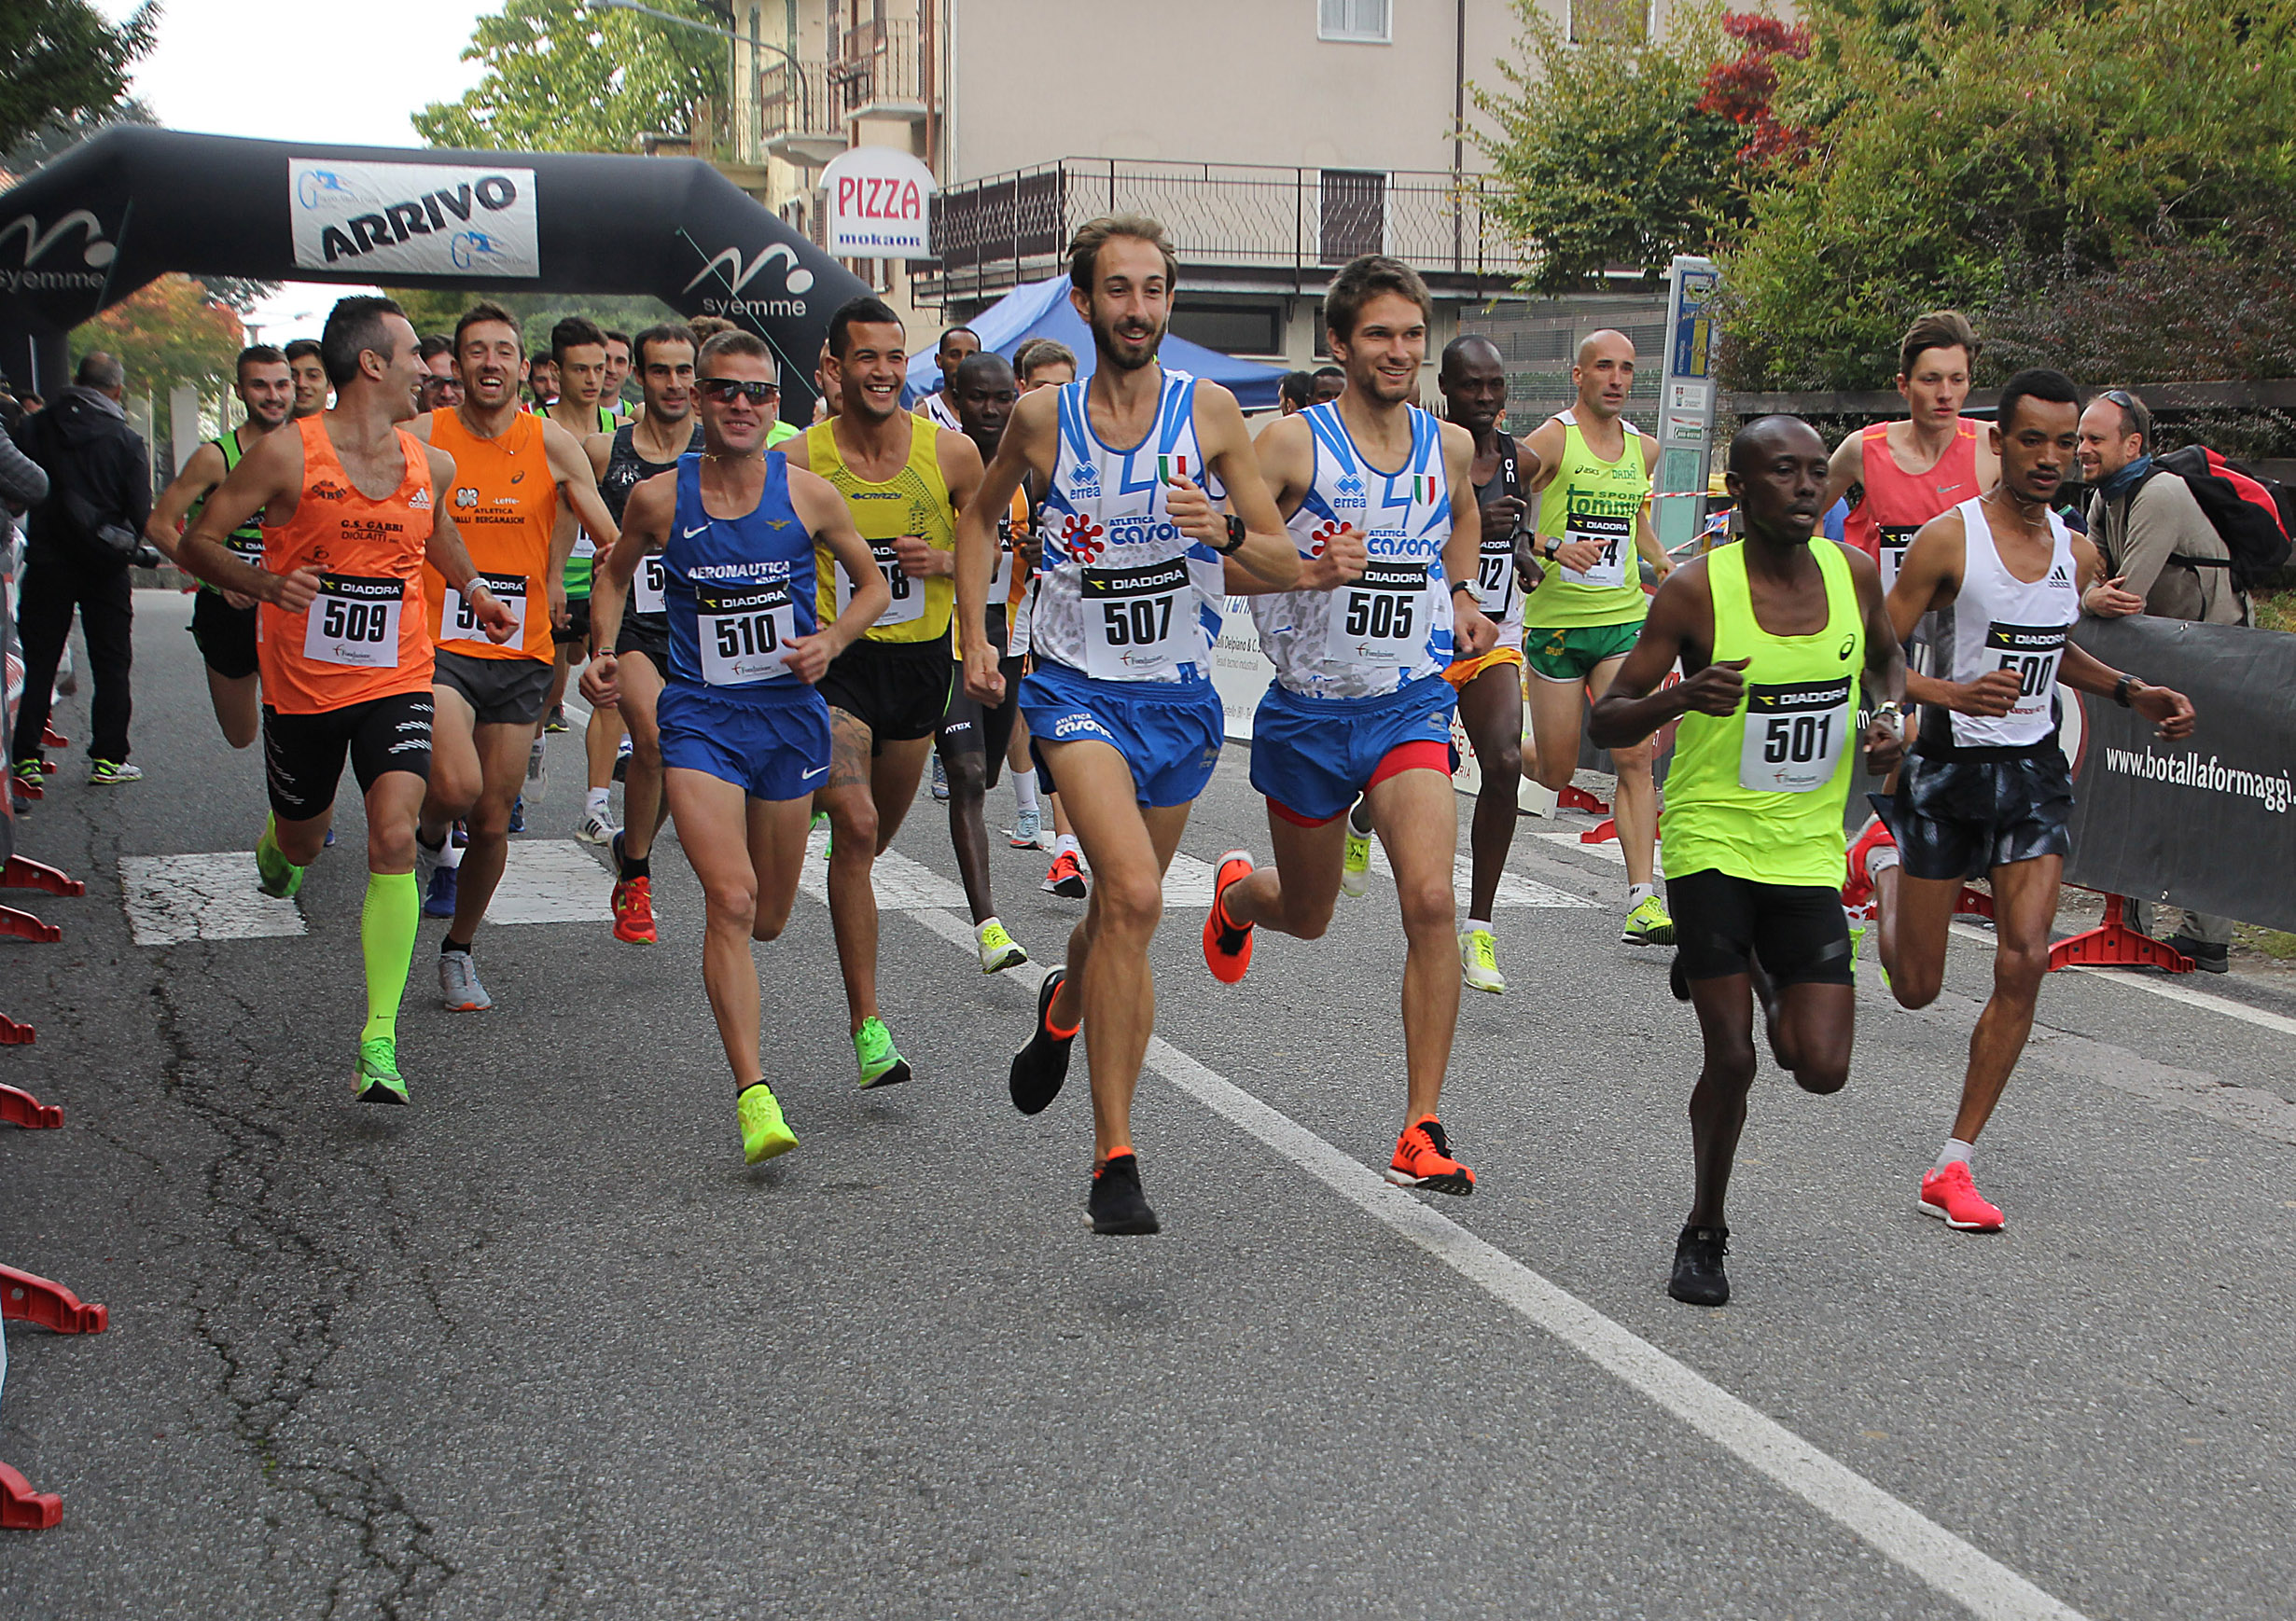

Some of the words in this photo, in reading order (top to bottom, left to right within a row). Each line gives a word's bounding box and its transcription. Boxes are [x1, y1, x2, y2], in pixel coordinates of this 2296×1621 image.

[839, 176, 921, 220] PIZZA
[322, 175, 517, 262] ARRIVO
[703, 298, 807, 317] syemme
[311, 484, 347, 500] GABBI
[1599, 492, 1642, 501] SPORT
[367, 521, 404, 533] GABBI
[1109, 517, 1156, 526] ATLETICA
[1587, 521, 1628, 532] DIADORA
[1480, 541, 1511, 549] ADORA
[688, 561, 790, 579] AERONAUTICA
[1111, 569, 1185, 589] DIADORA
[1364, 571, 1425, 583] DIADORA
[1479, 557, 1504, 590] 02
[341, 583, 400, 595] DIADORA
[491, 581, 523, 590] DORA
[721, 589, 787, 608] DIADORA
[323, 599, 387, 643] 509
[1103, 595, 1174, 646] 507
[1345, 591, 1414, 639] 505
[715, 614, 777, 658] 510
[1780, 687, 1847, 705] DIADORA
[1055, 713, 1092, 725] ATLETICA
[1764, 714, 1831, 763] 501
